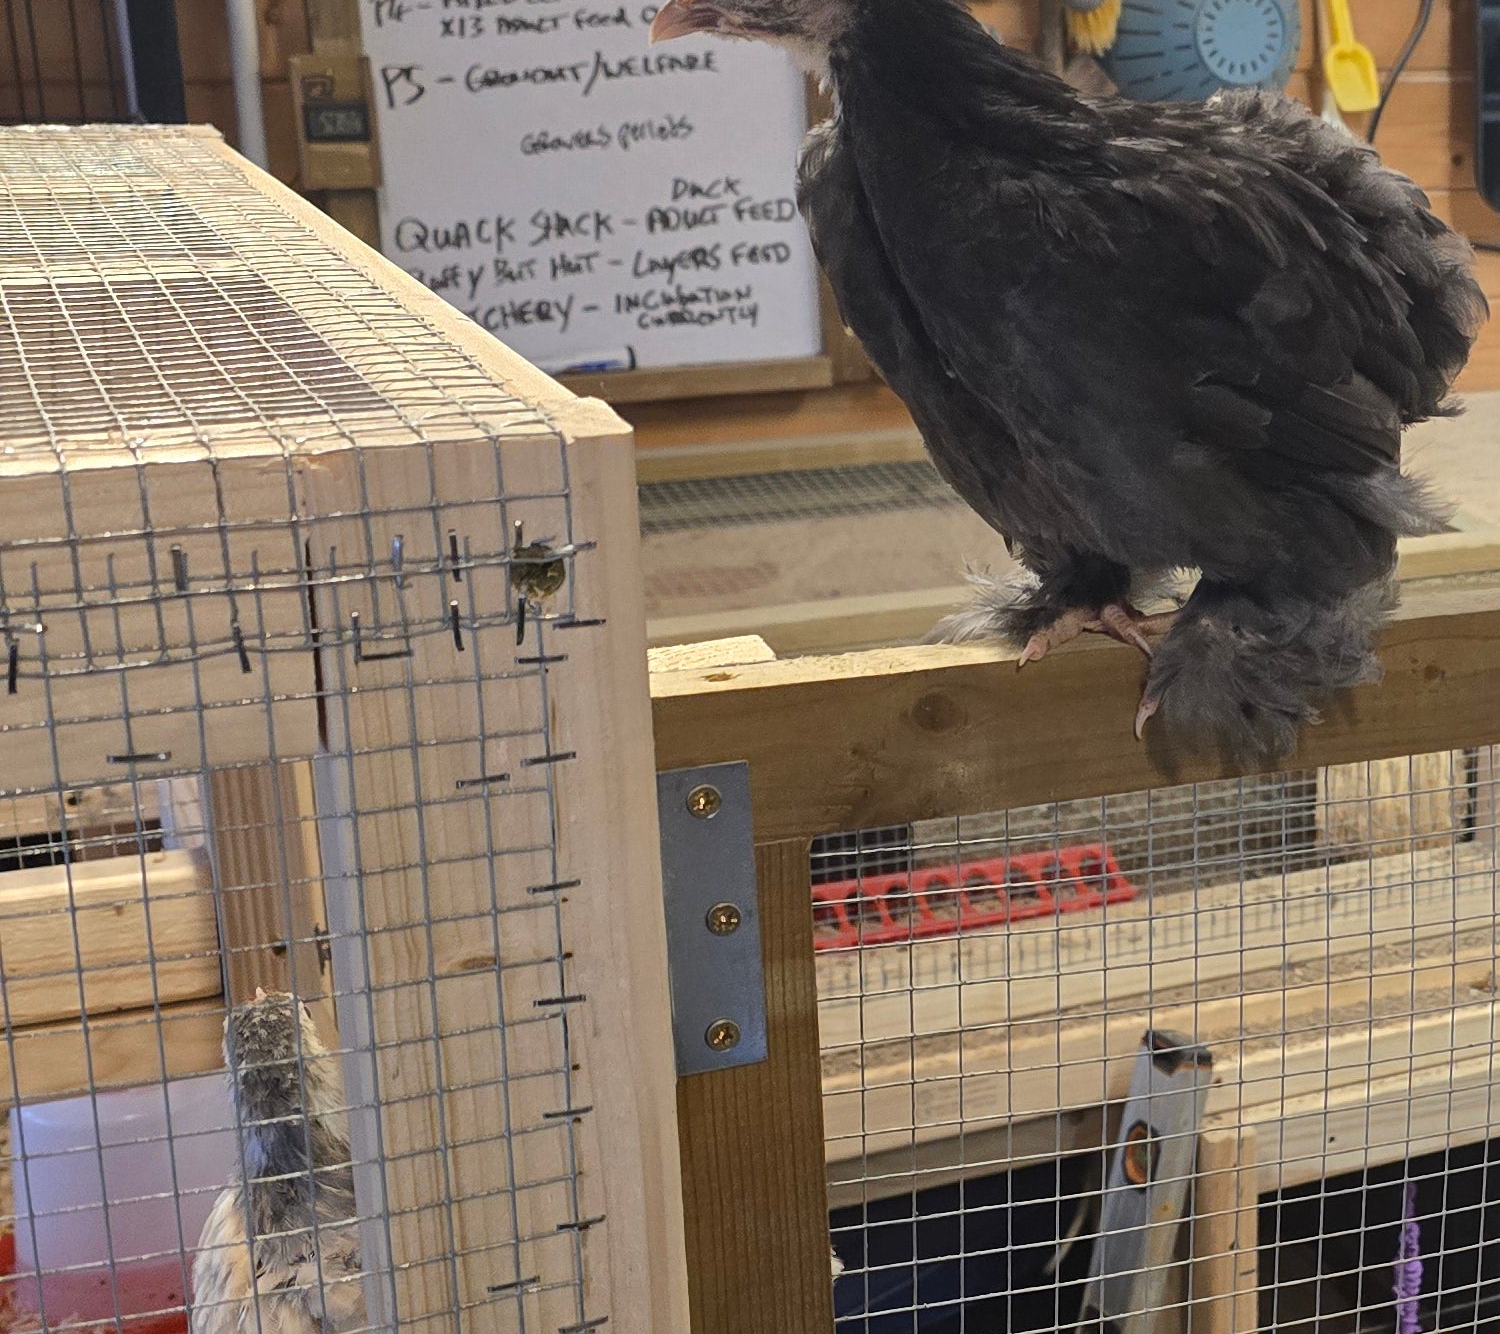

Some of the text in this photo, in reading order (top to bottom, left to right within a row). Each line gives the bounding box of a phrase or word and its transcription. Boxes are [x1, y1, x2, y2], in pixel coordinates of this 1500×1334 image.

[381, 63, 426, 108] P5
[395, 214, 516, 254] QUACK
[733, 196, 796, 223] FEED
[730, 241, 792, 268] FEED
